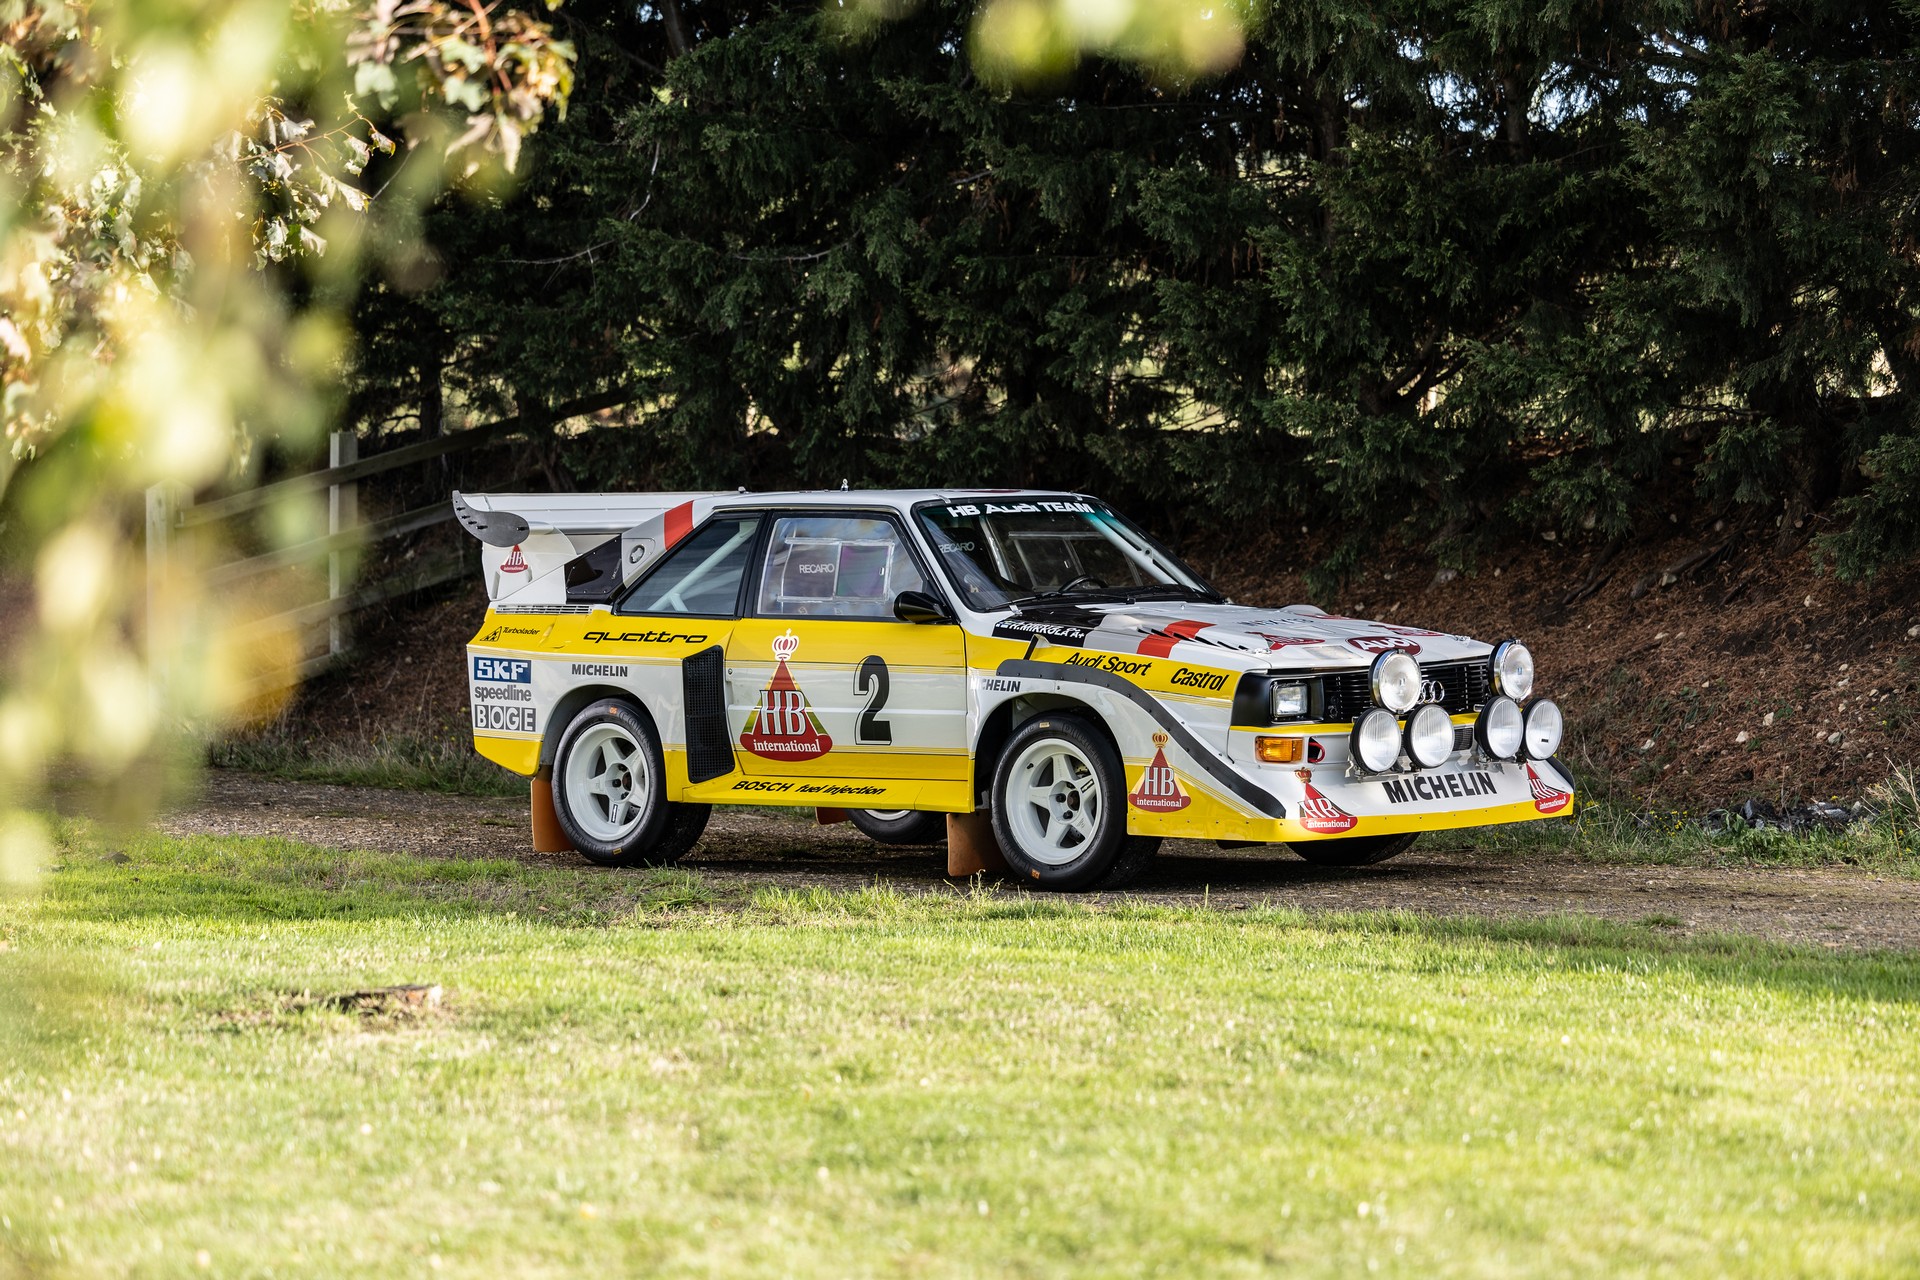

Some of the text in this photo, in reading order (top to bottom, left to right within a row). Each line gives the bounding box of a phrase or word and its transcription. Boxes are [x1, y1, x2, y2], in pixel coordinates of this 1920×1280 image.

[946, 504, 981, 517] HB
[1037, 502, 1096, 514] TEAM
[938, 541, 975, 554] RECARO
[507, 551, 523, 565] HB
[799, 563, 835, 574] RECARO
[502, 626, 541, 635] Turbolader
[583, 630, 708, 644] quattro
[476, 659, 529, 681] SKF
[571, 663, 629, 677] MICHELIN
[1063, 652, 1152, 676] Audi Sport
[1170, 667, 1230, 691] Castrol
[474, 684, 532, 702] speedline
[852, 654, 893, 746] 2
[475, 704, 536, 732] BOGE
[759, 689, 808, 736] HB
[753, 738, 822, 753] international
[731, 780, 887, 795] BOSCH fuel injection
[1144, 766, 1175, 796] HB
[1382, 772, 1498, 804] MICHELIN
[1529, 777, 1559, 799] HB
[1136, 797, 1182, 808] international
[1298, 798, 1340, 819] HB
[1539, 797, 1567, 810] international
[1306, 818, 1351, 828] international
